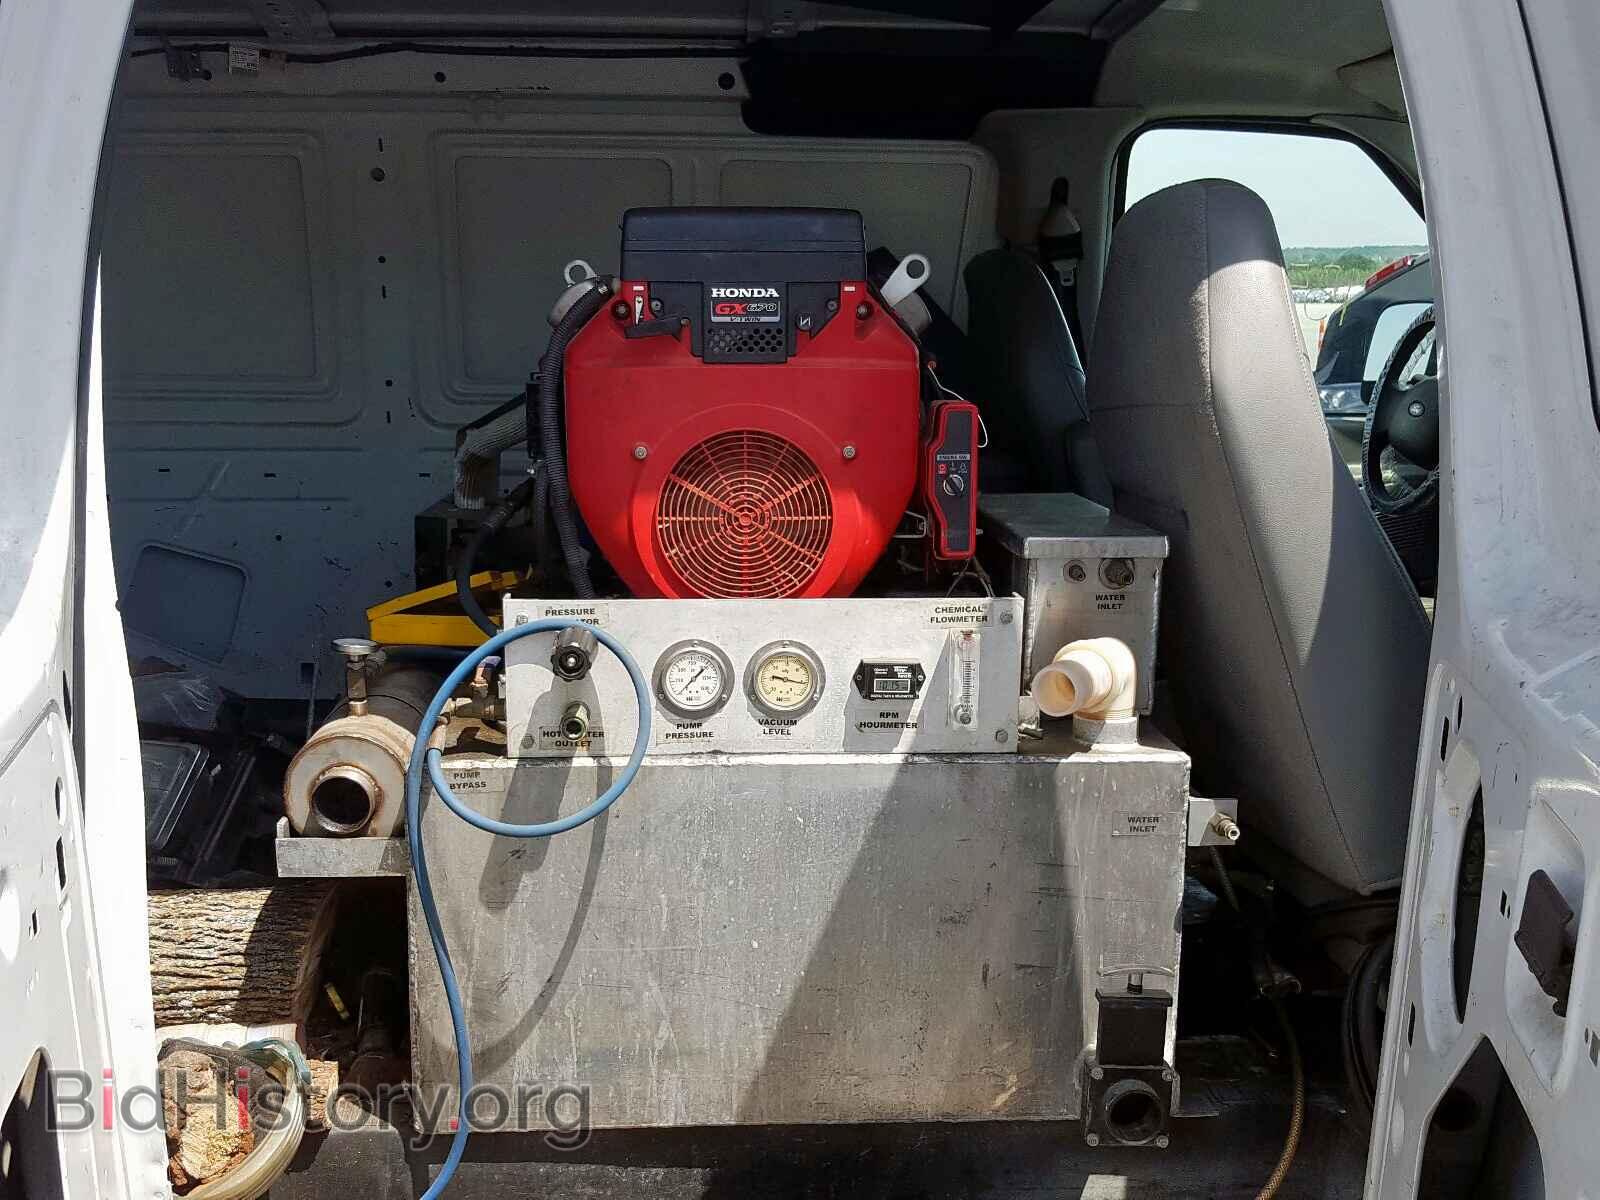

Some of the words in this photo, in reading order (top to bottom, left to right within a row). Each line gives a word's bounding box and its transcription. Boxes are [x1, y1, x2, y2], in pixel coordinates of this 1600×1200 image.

[711, 288, 779, 298] HONDA
[545, 608, 596, 617] PRESSURE
[935, 606, 984, 614] CHEMICAL
[930, 615, 988, 624] FLOWMETER
[676, 722, 703, 730] PUMP
[758, 718, 798, 726] VACUUM
[859, 721, 918, 729] HOURMETER
[665, 731, 715, 740] PRESSURE
[762, 728, 792, 736] LEVEL
[555, 740, 592, 748] OUTLET
[453, 771, 481, 779] PUMP
[449, 781, 487, 790] BYPASS
[1127, 816, 1160, 824] WATER
[1129, 825, 1157, 833] INLET
